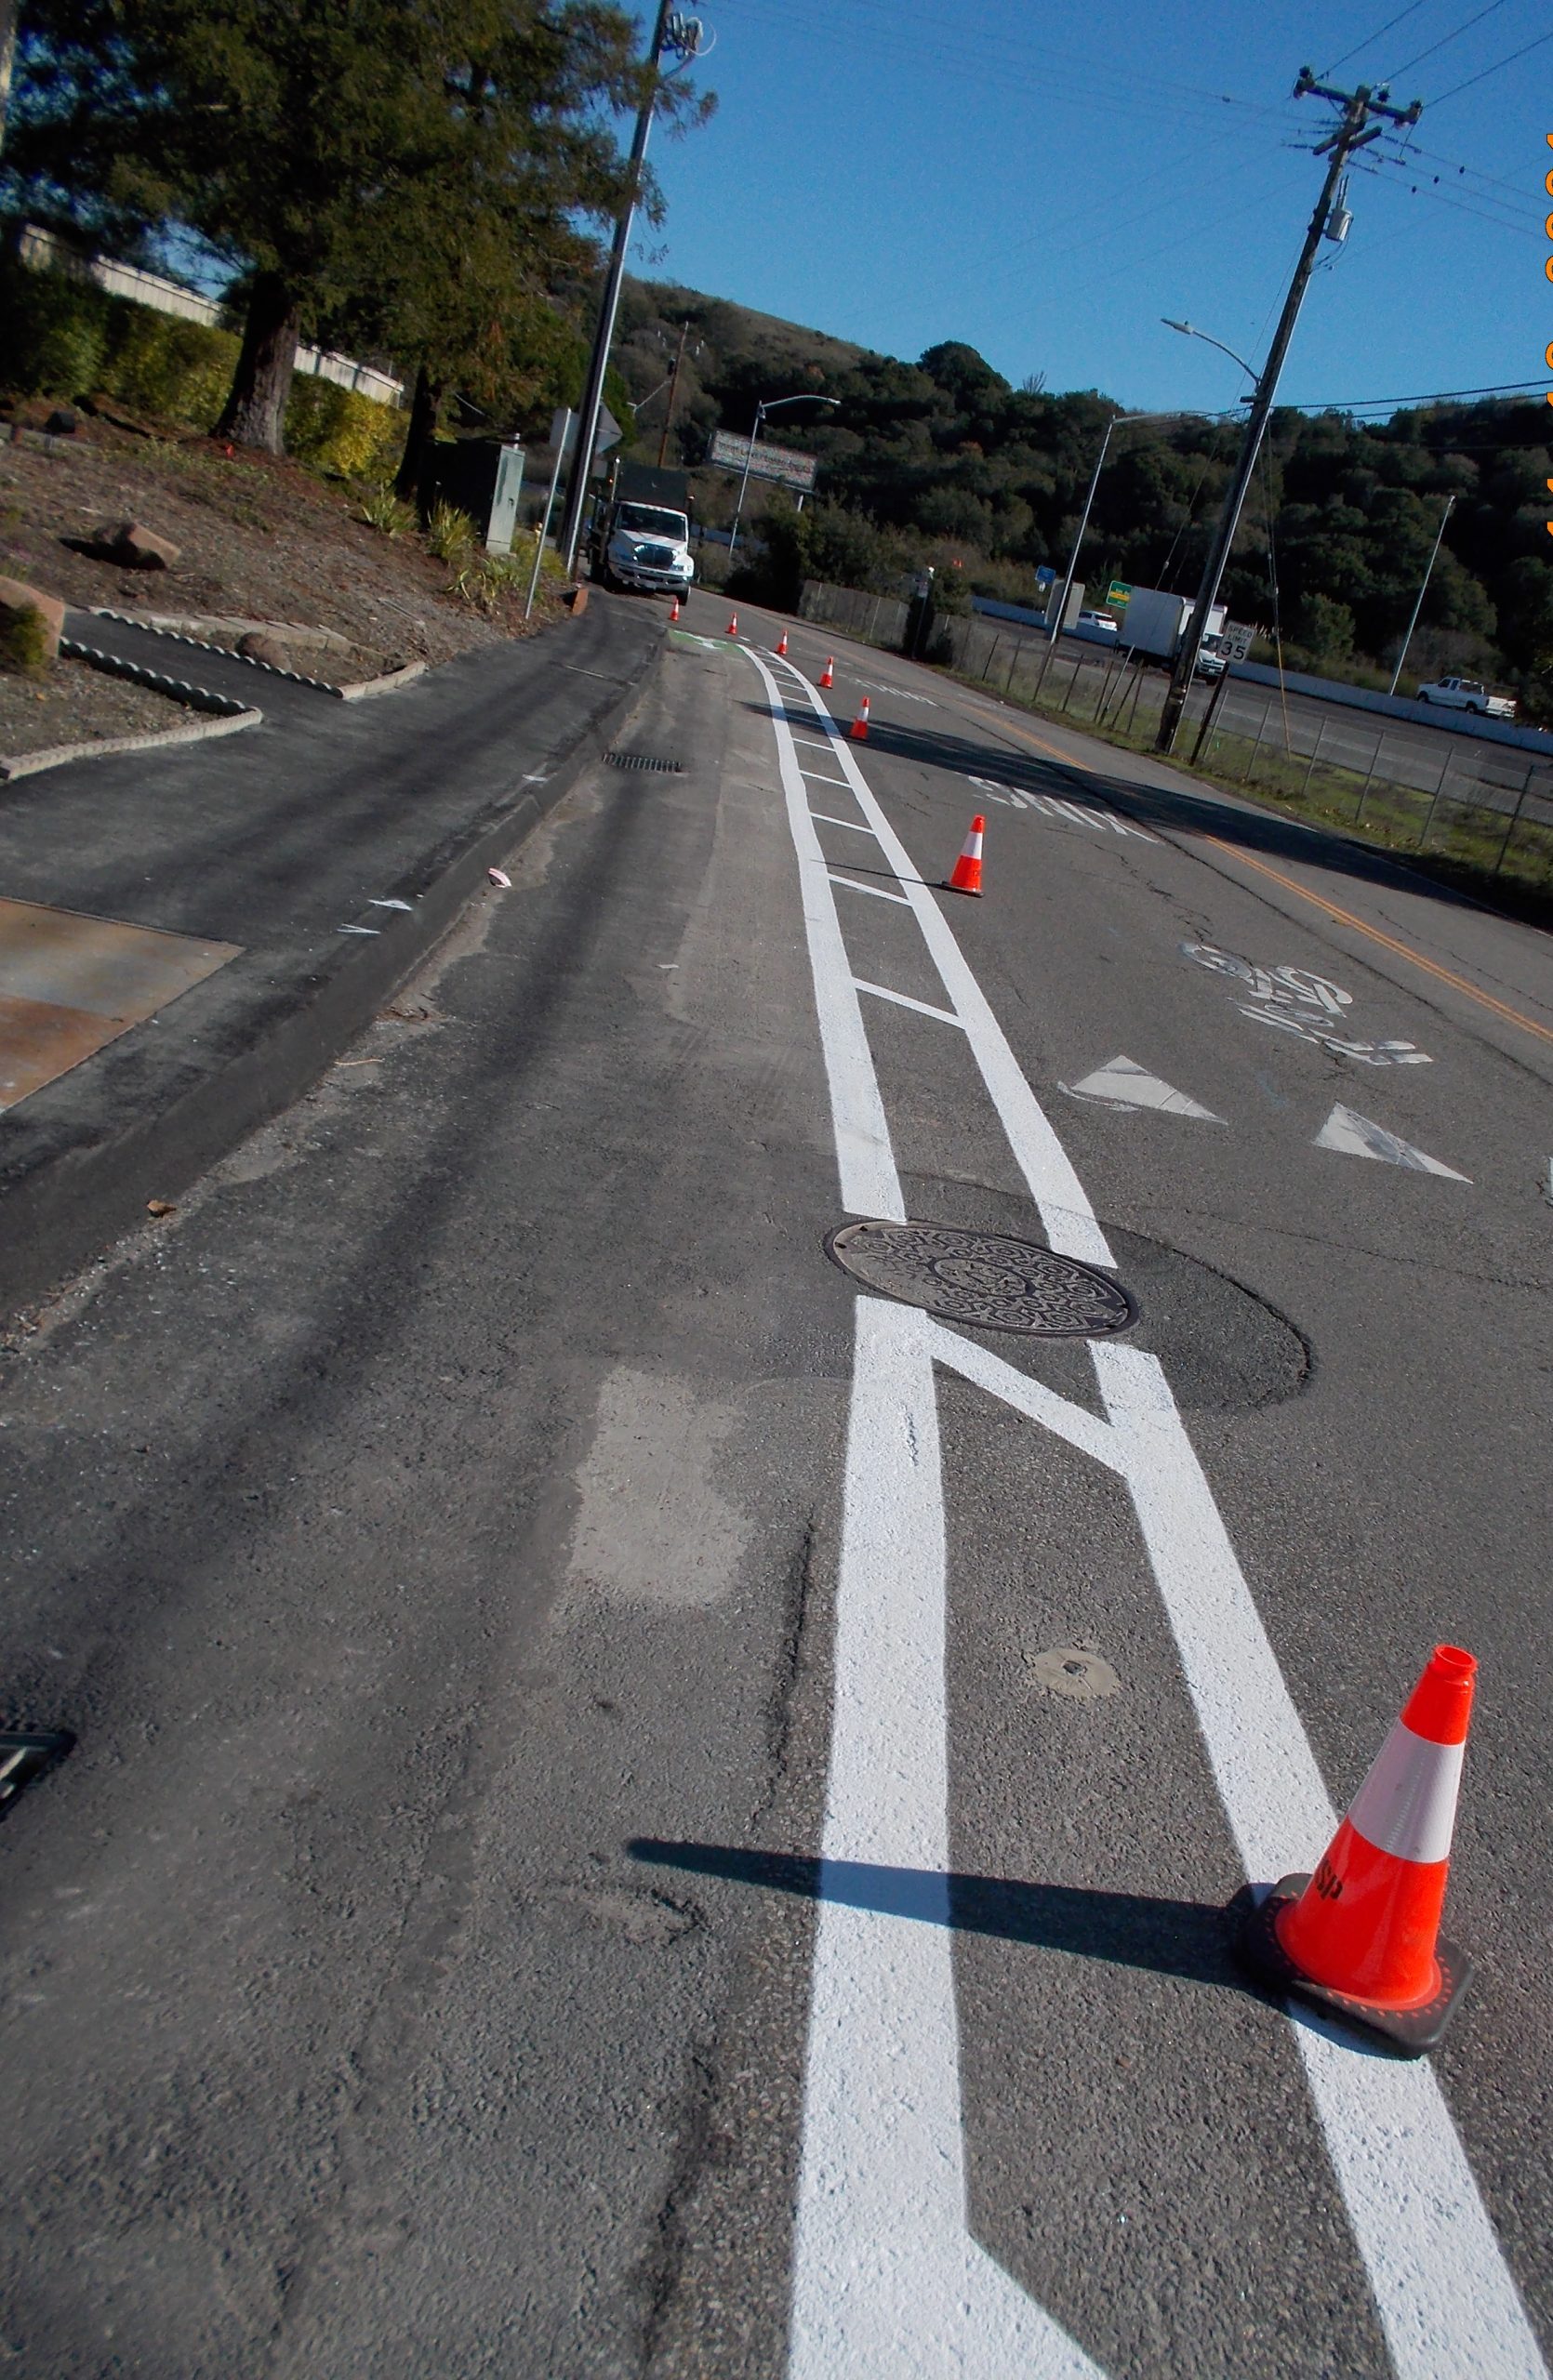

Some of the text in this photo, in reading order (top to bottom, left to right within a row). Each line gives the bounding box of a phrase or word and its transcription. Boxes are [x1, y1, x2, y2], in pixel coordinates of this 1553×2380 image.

[1228, 624, 1253, 638] SPEED
[1227, 634, 1248, 644] LIMIT
[1220, 641, 1246, 660] 35
